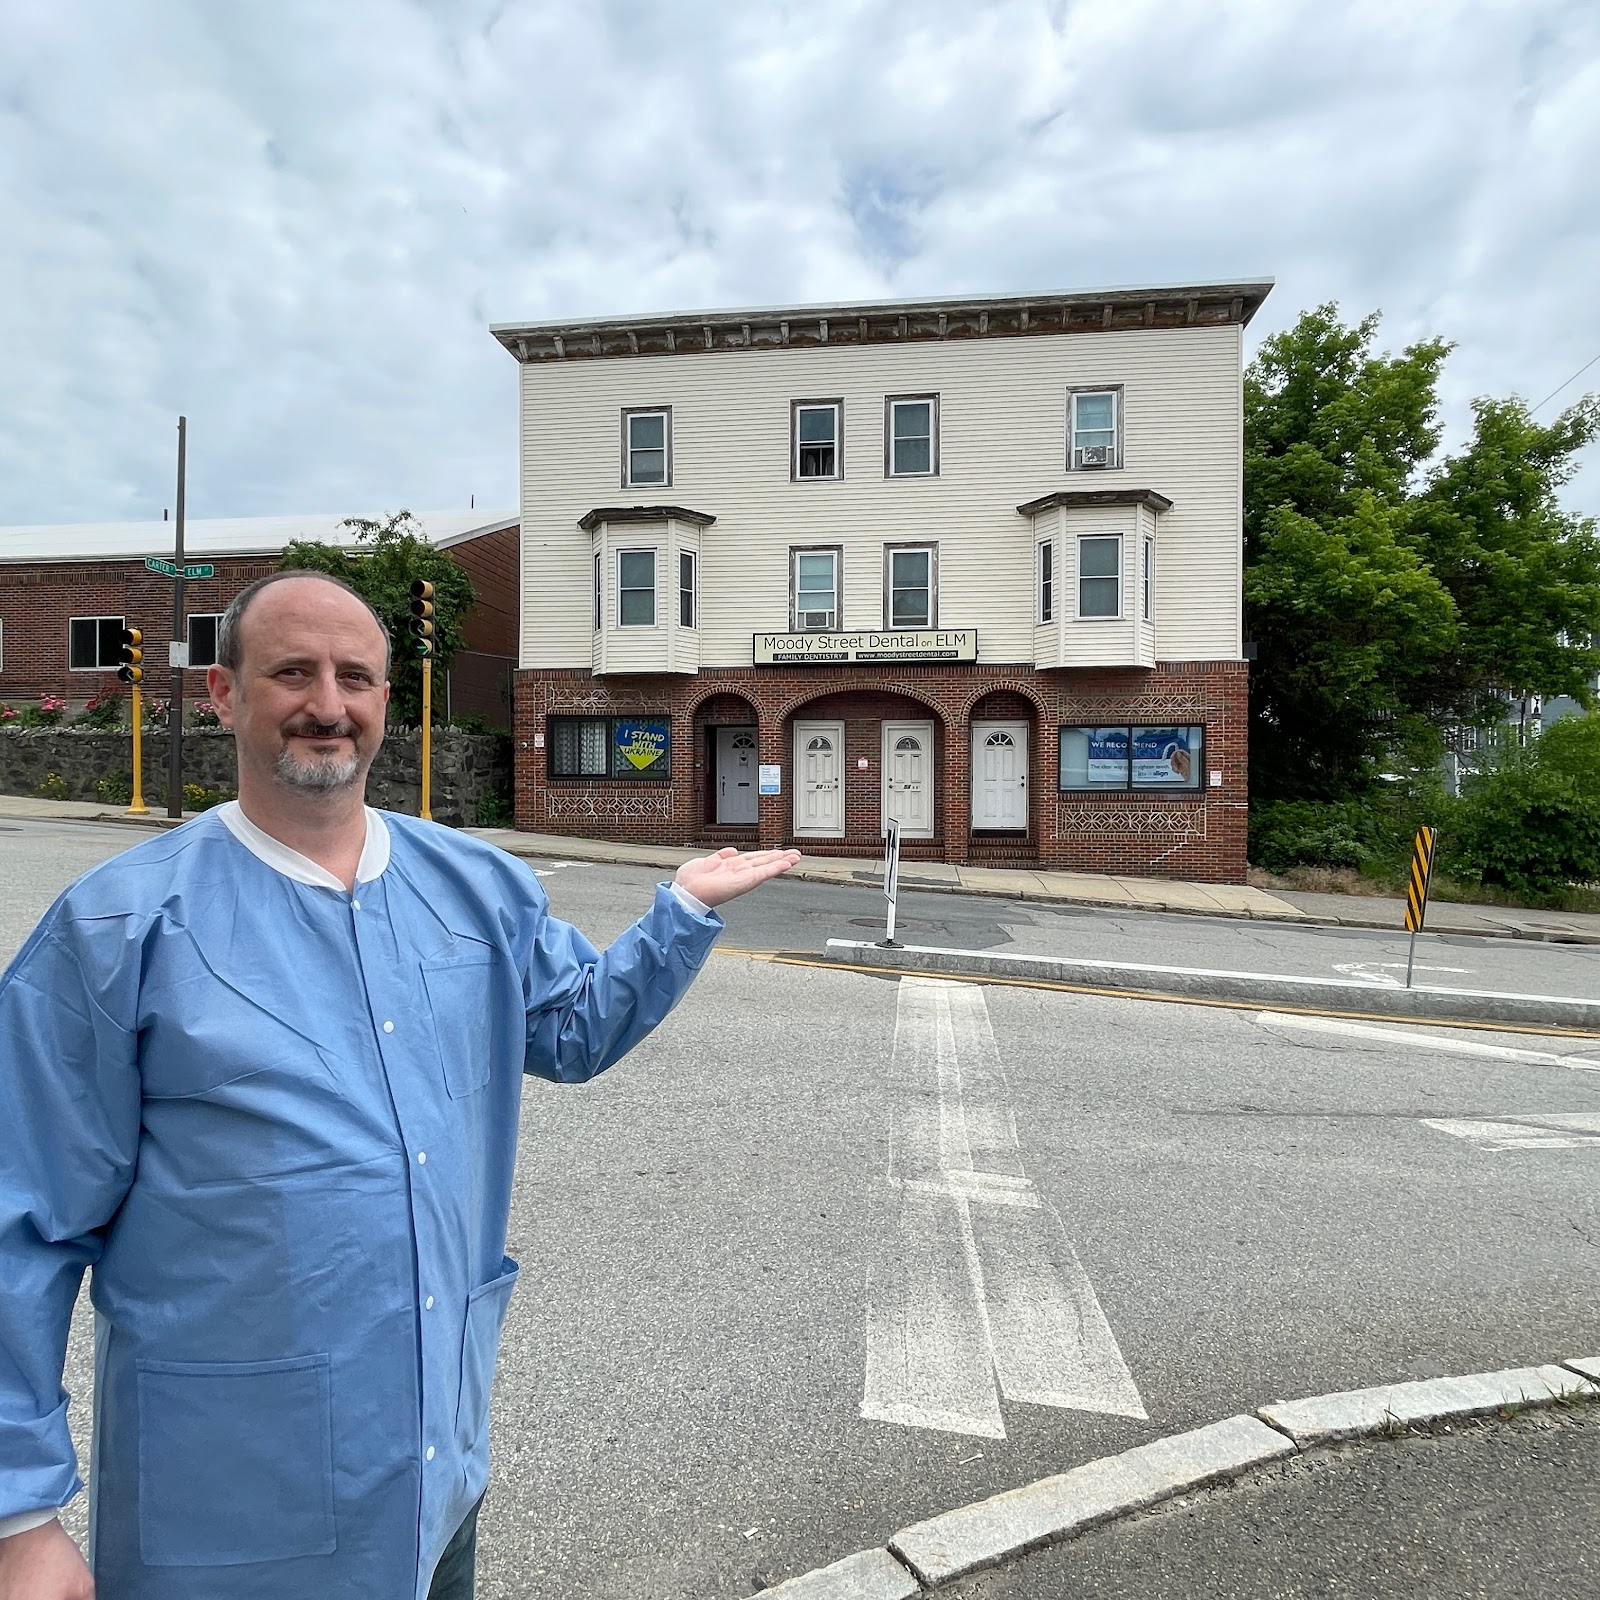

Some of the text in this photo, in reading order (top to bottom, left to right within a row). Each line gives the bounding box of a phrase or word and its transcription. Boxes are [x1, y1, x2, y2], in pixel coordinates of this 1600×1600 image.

[147, 559, 170, 573] CARTER
[187, 567, 202, 576] ELM
[764, 637, 813, 651] Moody
[818, 635, 864, 649] Street
[869, 634, 918, 648] Dental
[936, 633, 966, 647] ELM
[858, 651, 957, 659] www.moodystreetdental.com
[624, 729, 665, 742] I STAND
[632, 740, 656, 749] WITH
[624, 748, 660, 756] UKRAINE
[1091, 748, 1158, 758] INVISAIGN
